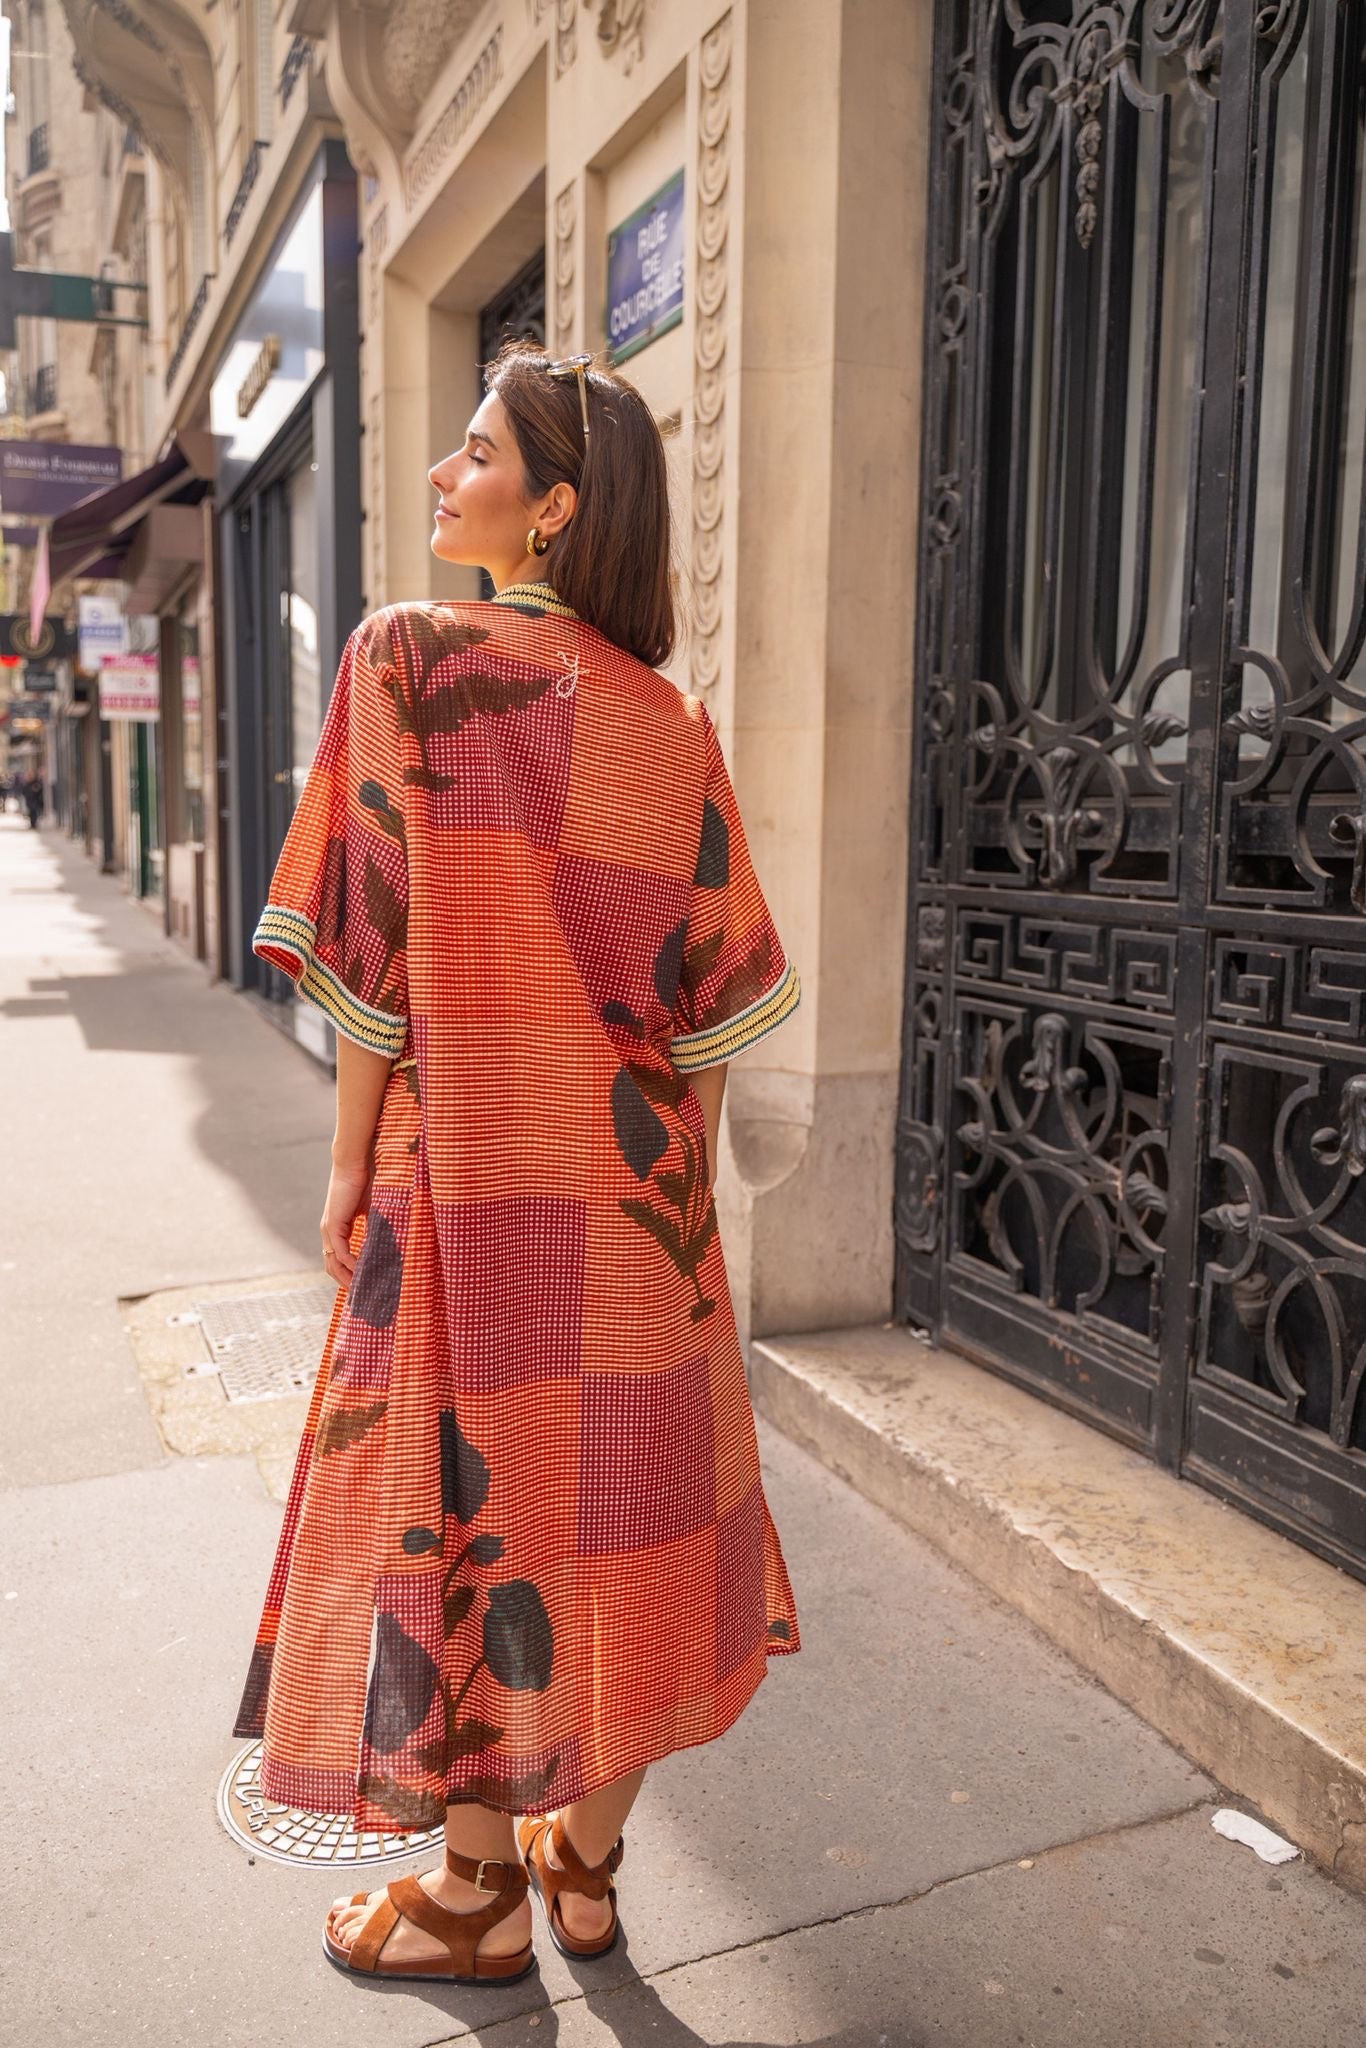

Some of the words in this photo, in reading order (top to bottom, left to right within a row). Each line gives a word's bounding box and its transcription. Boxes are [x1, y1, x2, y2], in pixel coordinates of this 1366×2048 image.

[638, 211, 667, 259] RUE
[642, 252, 661, 282] DE
[610, 261, 683, 337] COURCELLE
